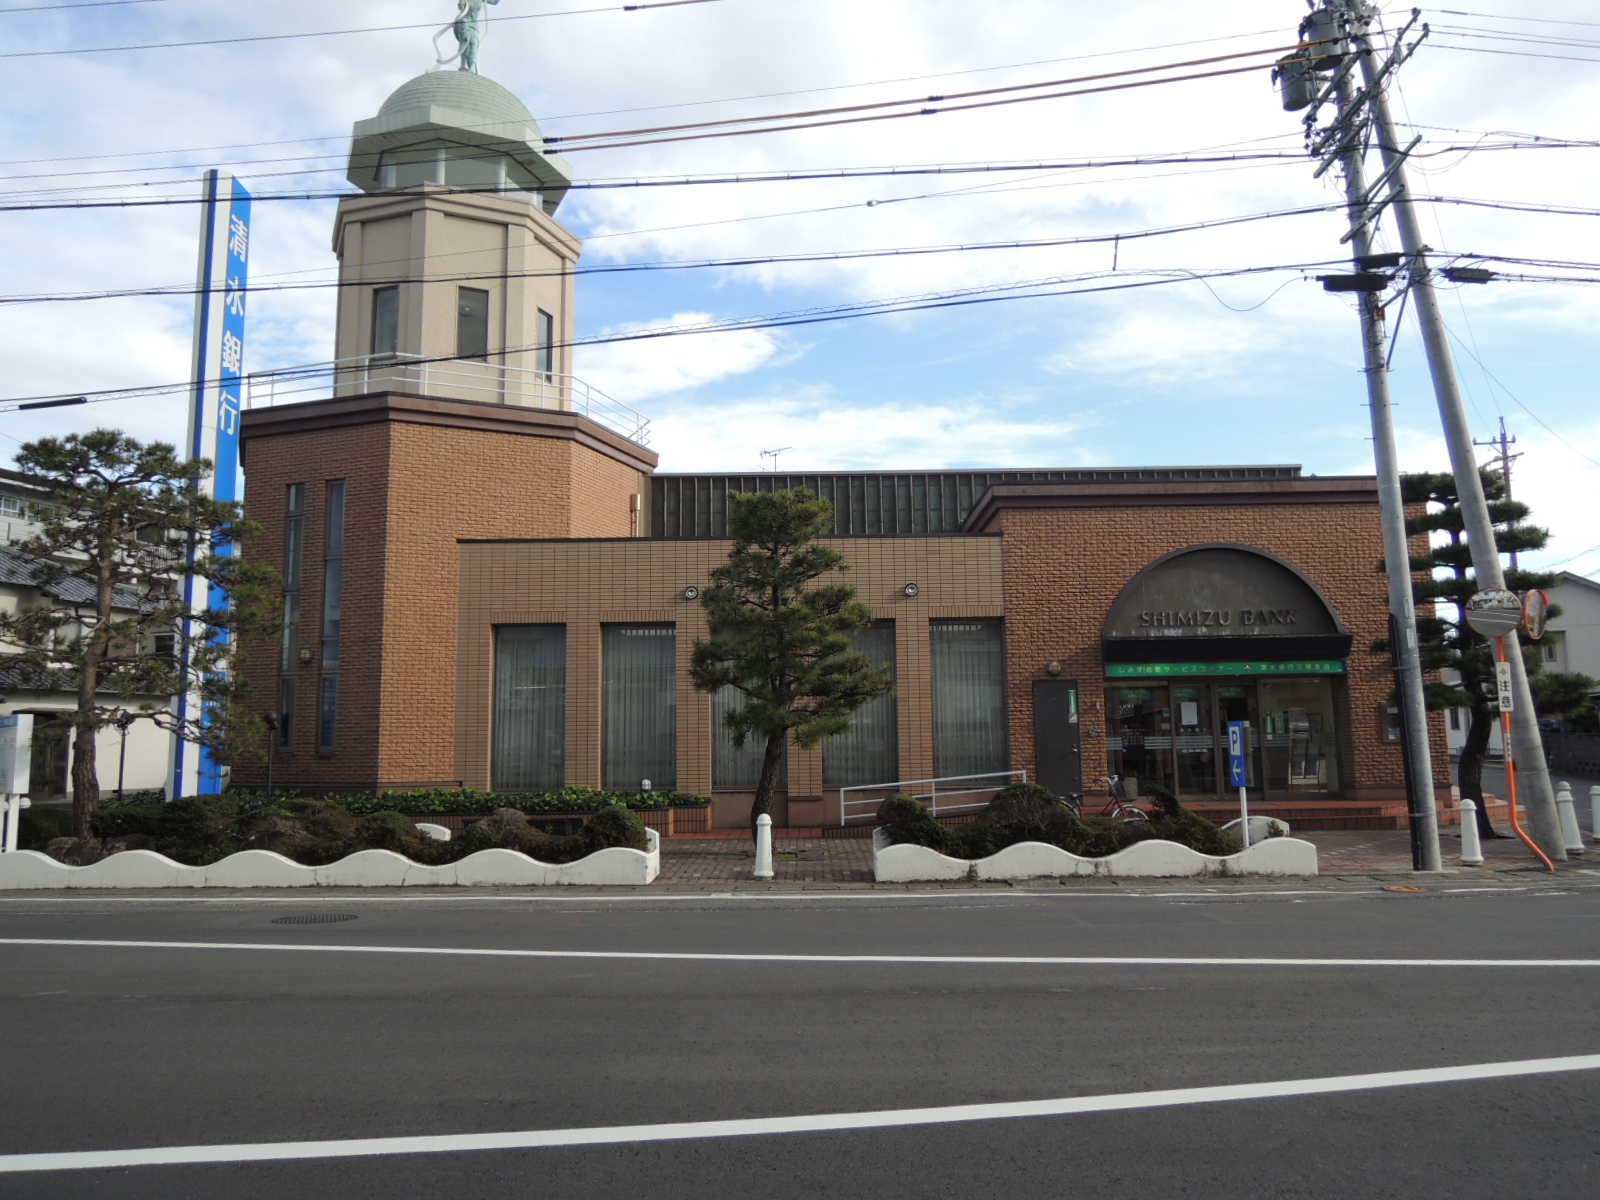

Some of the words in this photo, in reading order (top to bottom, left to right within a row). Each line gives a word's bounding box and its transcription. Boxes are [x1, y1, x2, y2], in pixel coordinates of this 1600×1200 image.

[219, 214, 249, 435] 清水銀行
[1140, 609, 1232, 626] SHIMIZU
[1243, 608, 1297, 625] BANK
[1499, 679, 1511, 708] 注意
[1231, 730, 1238, 752] P
